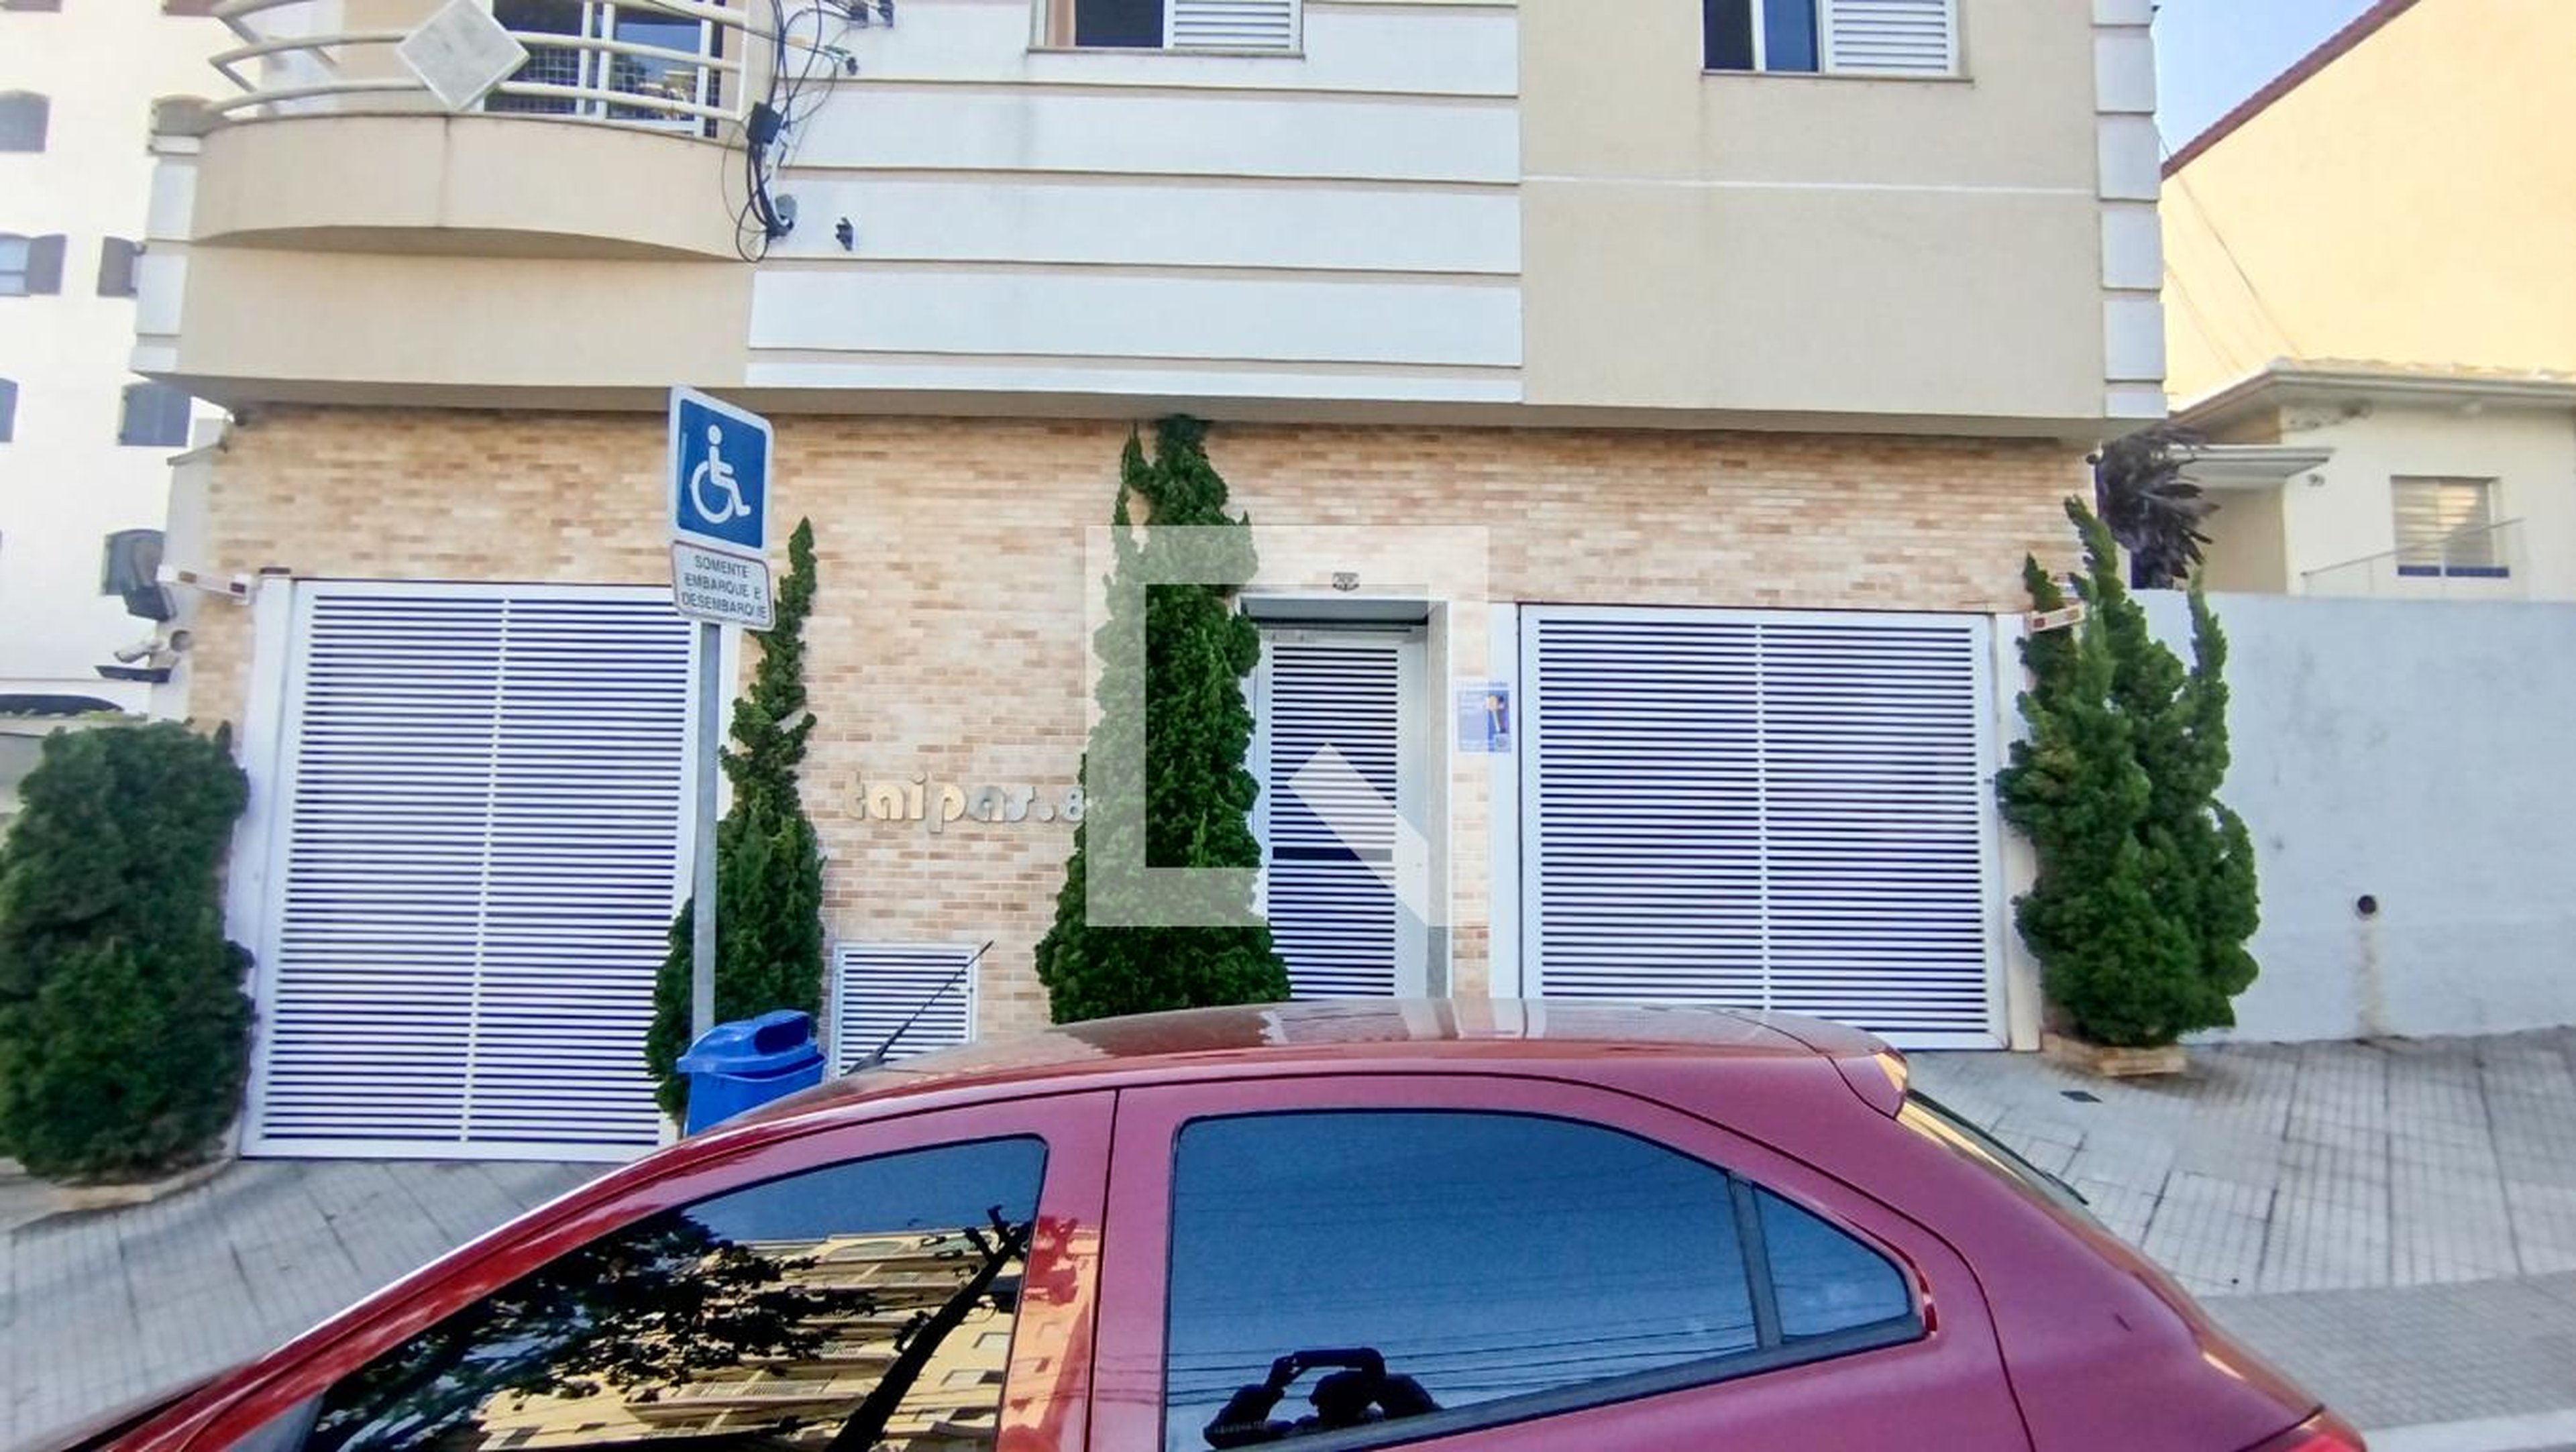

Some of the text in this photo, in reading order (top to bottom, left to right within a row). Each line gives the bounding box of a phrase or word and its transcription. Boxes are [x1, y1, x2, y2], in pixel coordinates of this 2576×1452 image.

[694, 555, 750, 578] SOMENTE
[684, 572, 761, 600] EMBARQUE E
[682, 592, 767, 618] DESEMBARQUE
